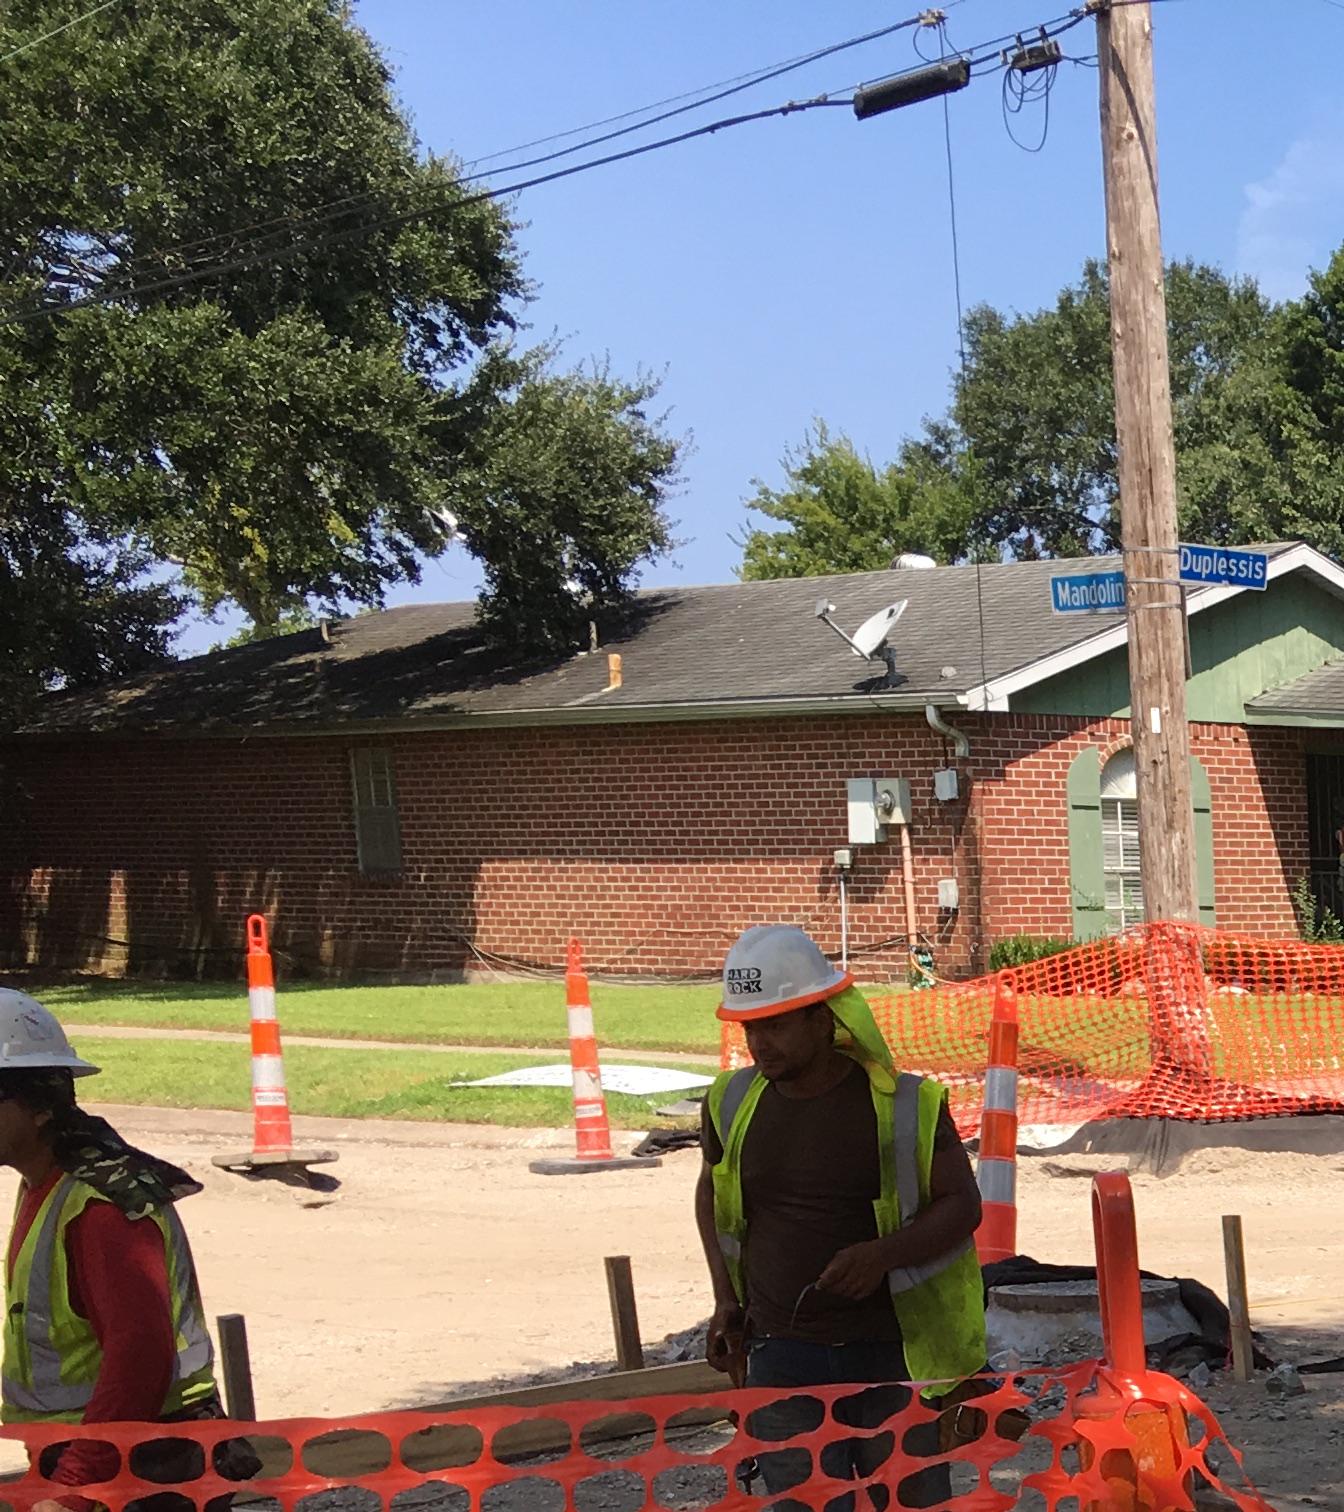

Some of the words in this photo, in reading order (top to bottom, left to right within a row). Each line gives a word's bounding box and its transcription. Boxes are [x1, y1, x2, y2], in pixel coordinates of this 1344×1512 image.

[1180, 548, 1264, 580] Duplessis
[1056, 578, 1125, 608] Mandolin
[727, 980, 763, 994] ROCK
